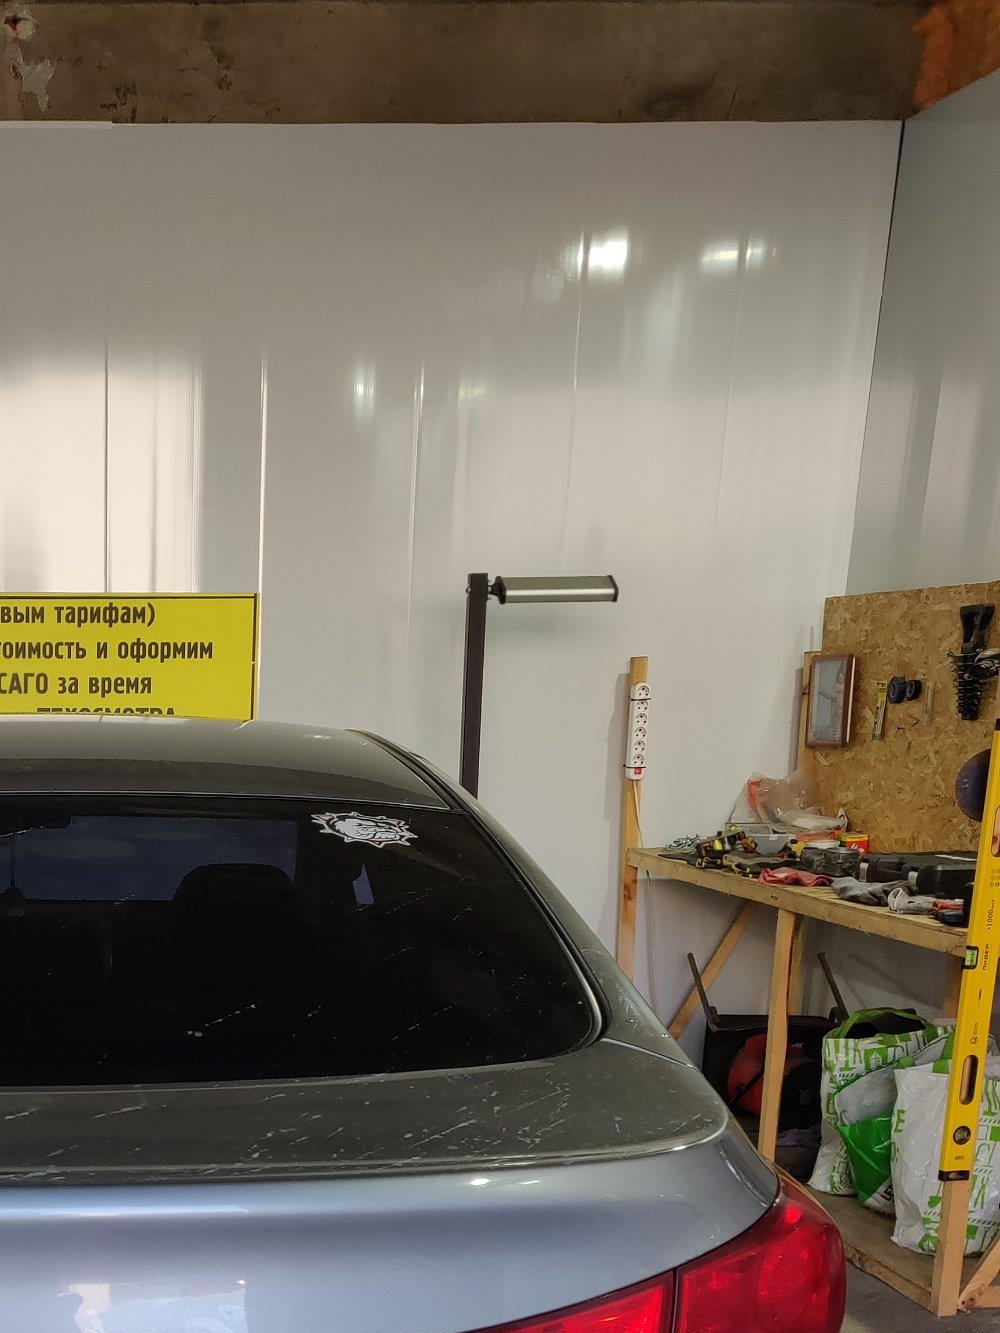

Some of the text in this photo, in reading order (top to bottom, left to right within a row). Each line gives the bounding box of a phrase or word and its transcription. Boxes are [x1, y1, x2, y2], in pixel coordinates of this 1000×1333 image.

[54, 601, 156, 627] тарифам)
[96, 641, 108, 659] и
[117, 637, 213, 664] оформим
[57, 676, 79, 695] за
[88, 676, 152, 699] время
